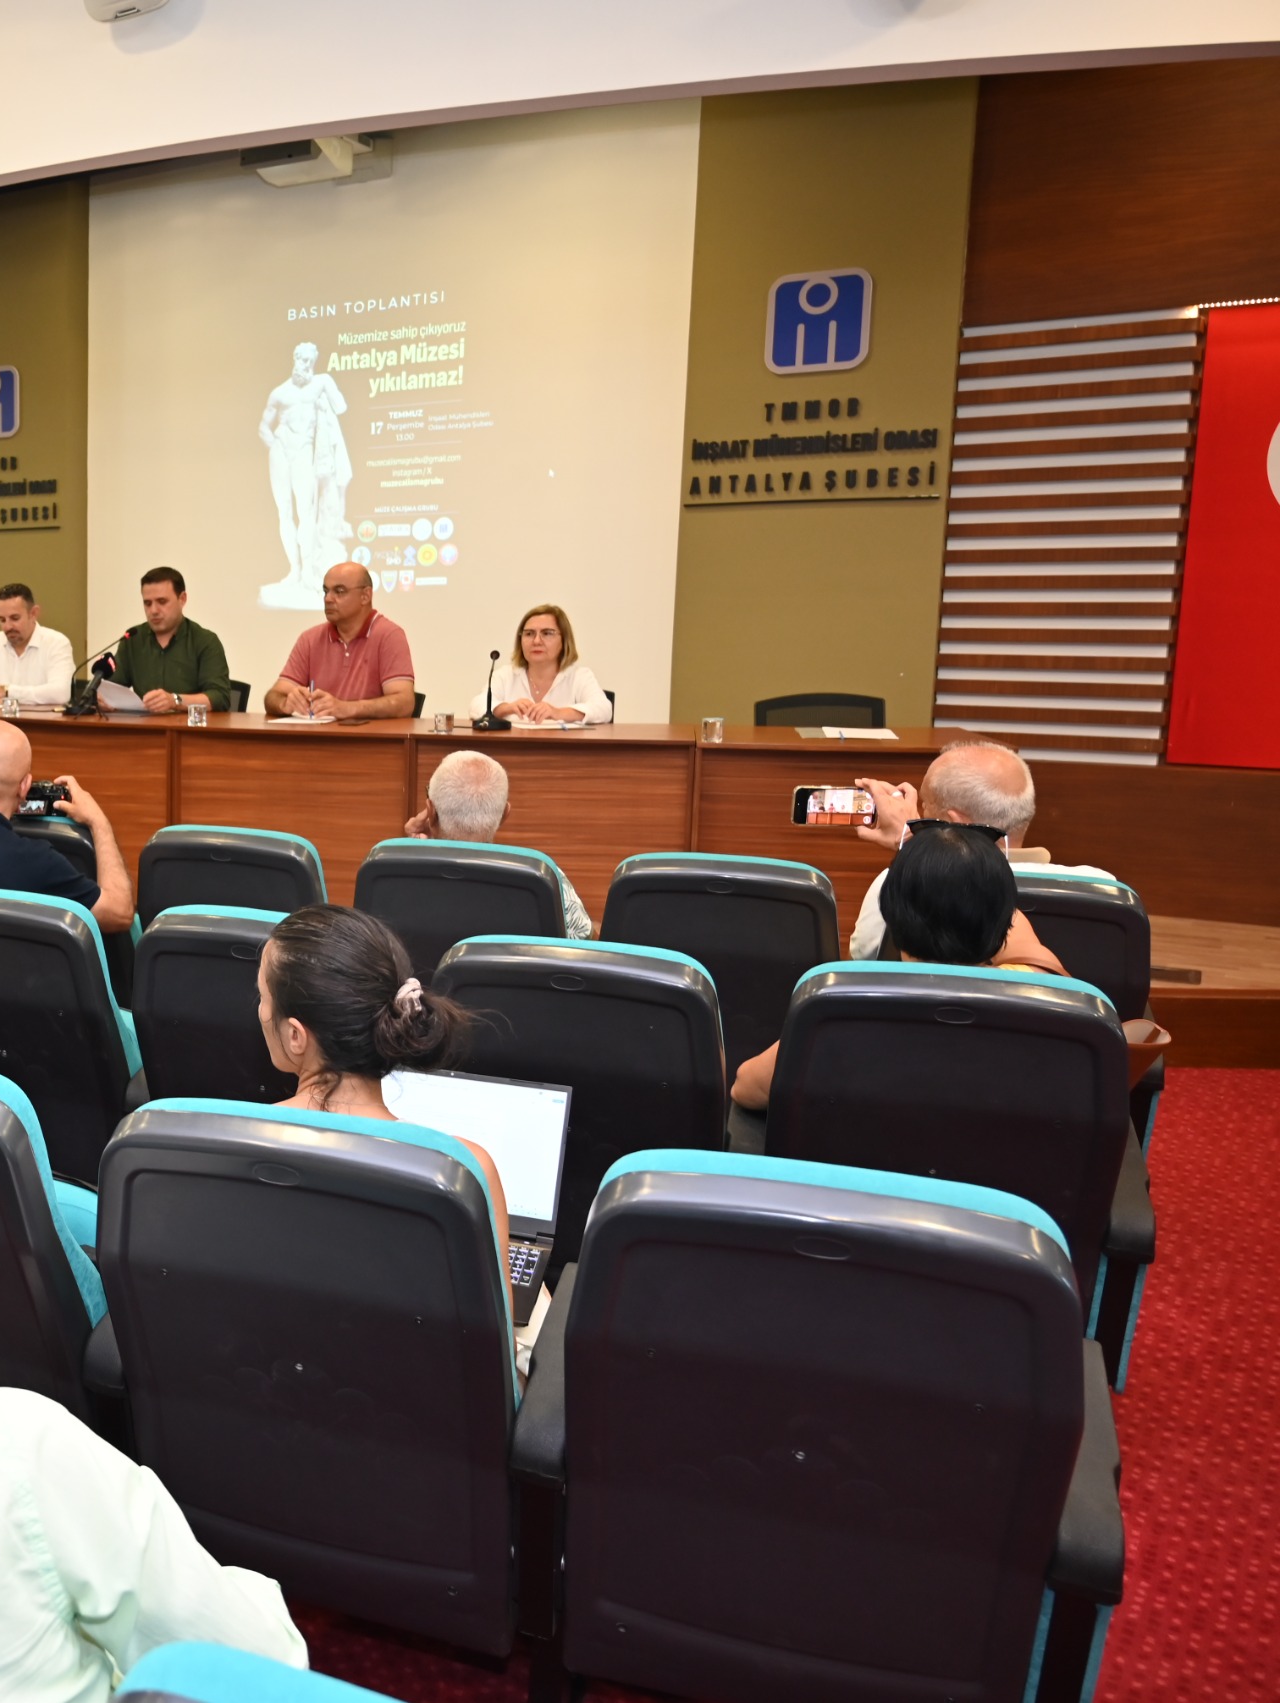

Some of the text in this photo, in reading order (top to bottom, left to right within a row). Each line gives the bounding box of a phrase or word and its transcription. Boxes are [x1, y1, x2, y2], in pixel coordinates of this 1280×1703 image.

[288, 290, 446, 321] BASIN TOPLANTISI
[338, 320, 466, 346] Müzemize sahip çıkıyoruz
[327, 338, 466, 373] Antalya Müzesi
[369, 366, 463, 398] yıkılamaz!
[388, 409, 423, 420] TEMMUZ
[764, 398, 860, 423] TMMOB
[370, 422, 384, 435] 17
[387, 421, 424, 432] Perşembe
[396, 433, 415, 442] 13.00
[691, 438, 749, 462] İNŞAAT
[884, 428, 938, 451] ODASI
[689, 461, 936, 496] ANTALYA ŞUBESİ
